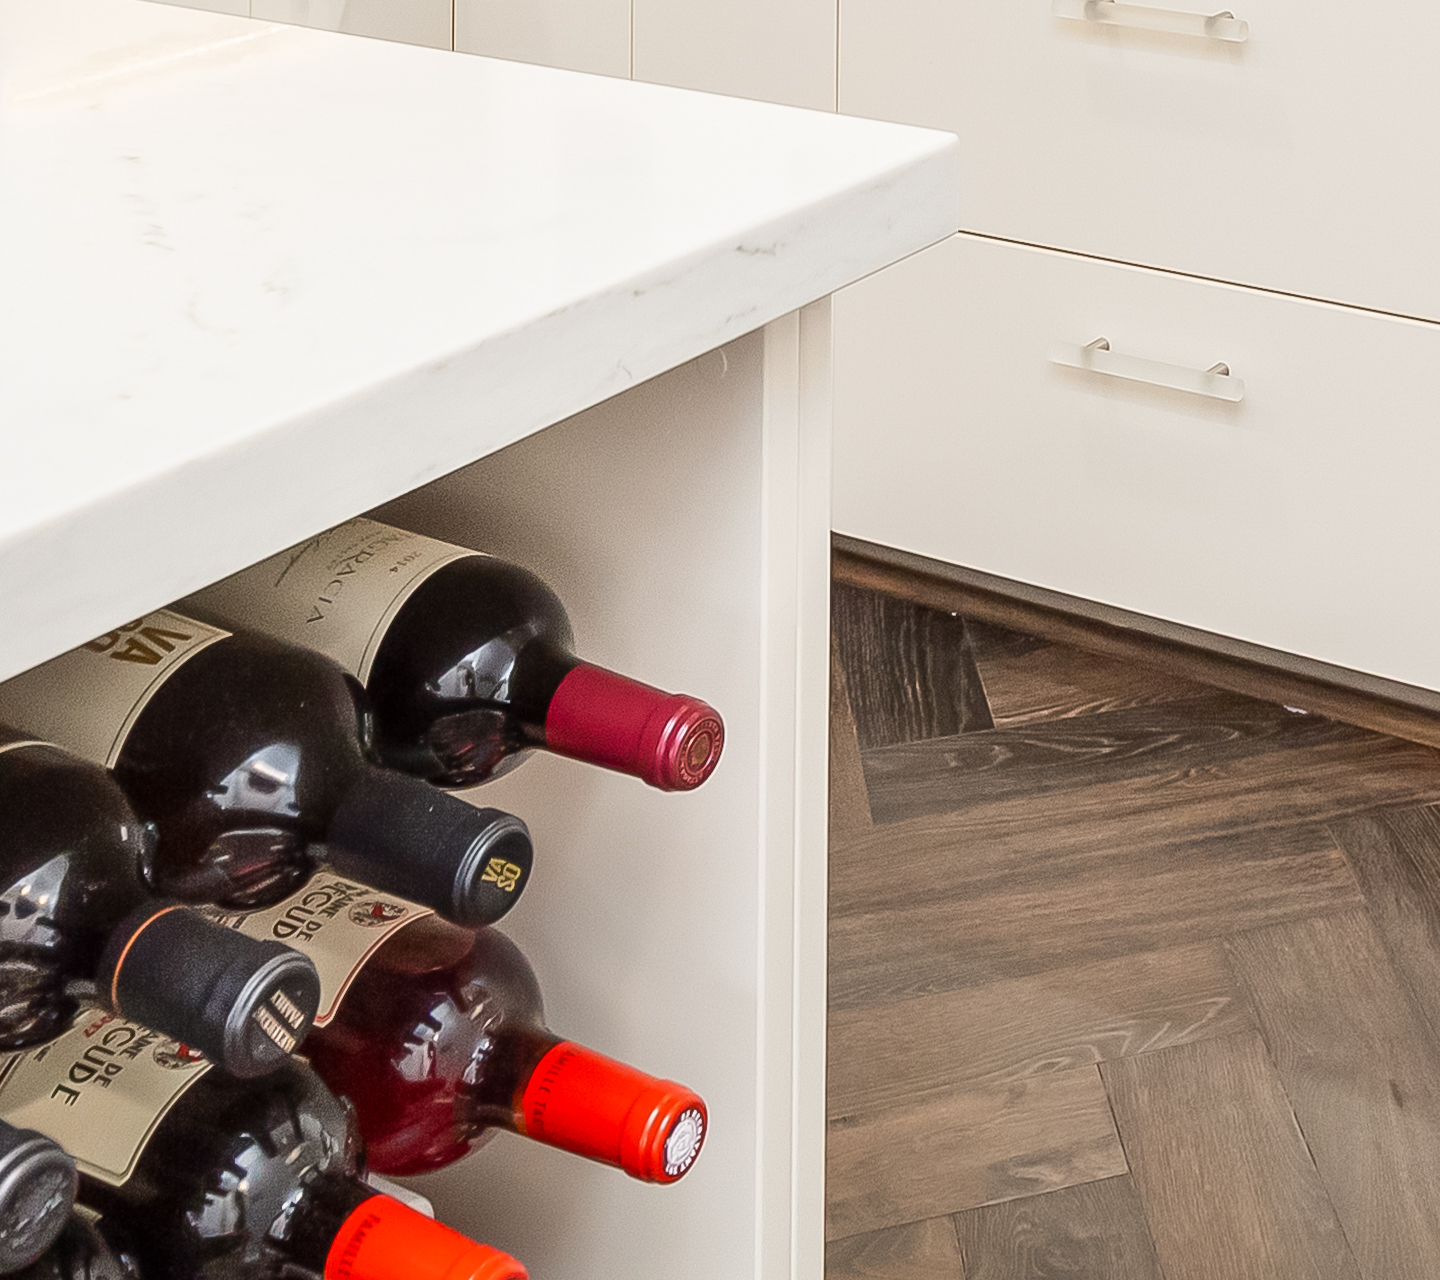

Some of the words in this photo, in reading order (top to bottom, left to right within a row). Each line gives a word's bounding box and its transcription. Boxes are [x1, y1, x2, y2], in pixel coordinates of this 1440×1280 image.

[110, 626, 192, 665] VA
[297, 918, 323, 942] DE
[50, 1027, 136, 1107] GUDE
[93, 1062, 123, 1089] DE
